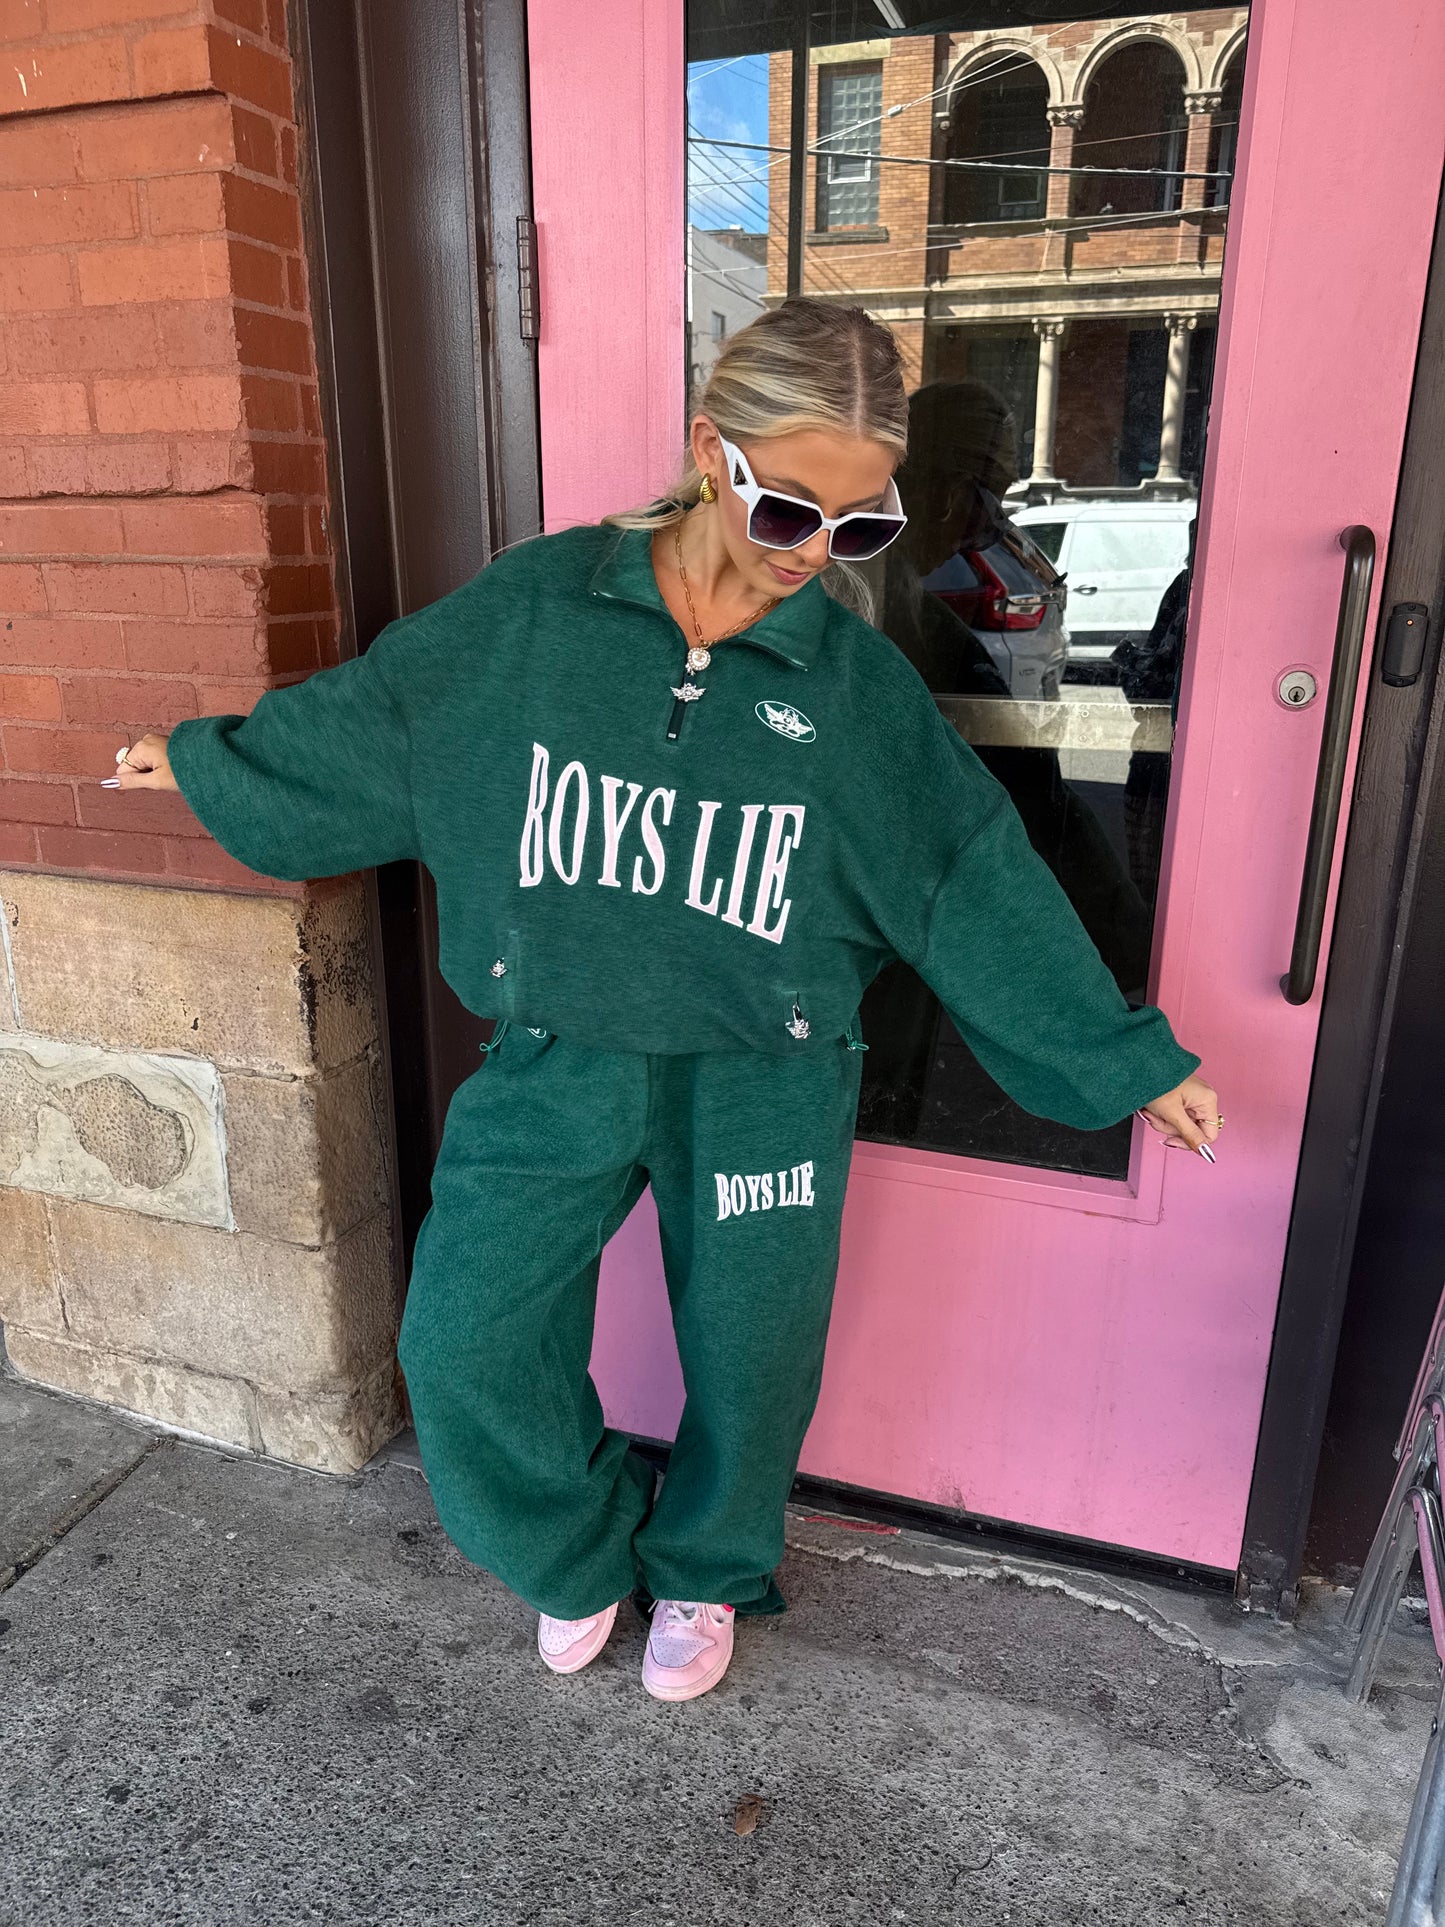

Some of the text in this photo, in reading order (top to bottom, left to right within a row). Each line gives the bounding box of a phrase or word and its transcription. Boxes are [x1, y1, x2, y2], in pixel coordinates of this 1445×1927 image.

[519, 741, 806, 945] BOYS LIE
[714, 1160, 815, 1222] BOYS LIE
